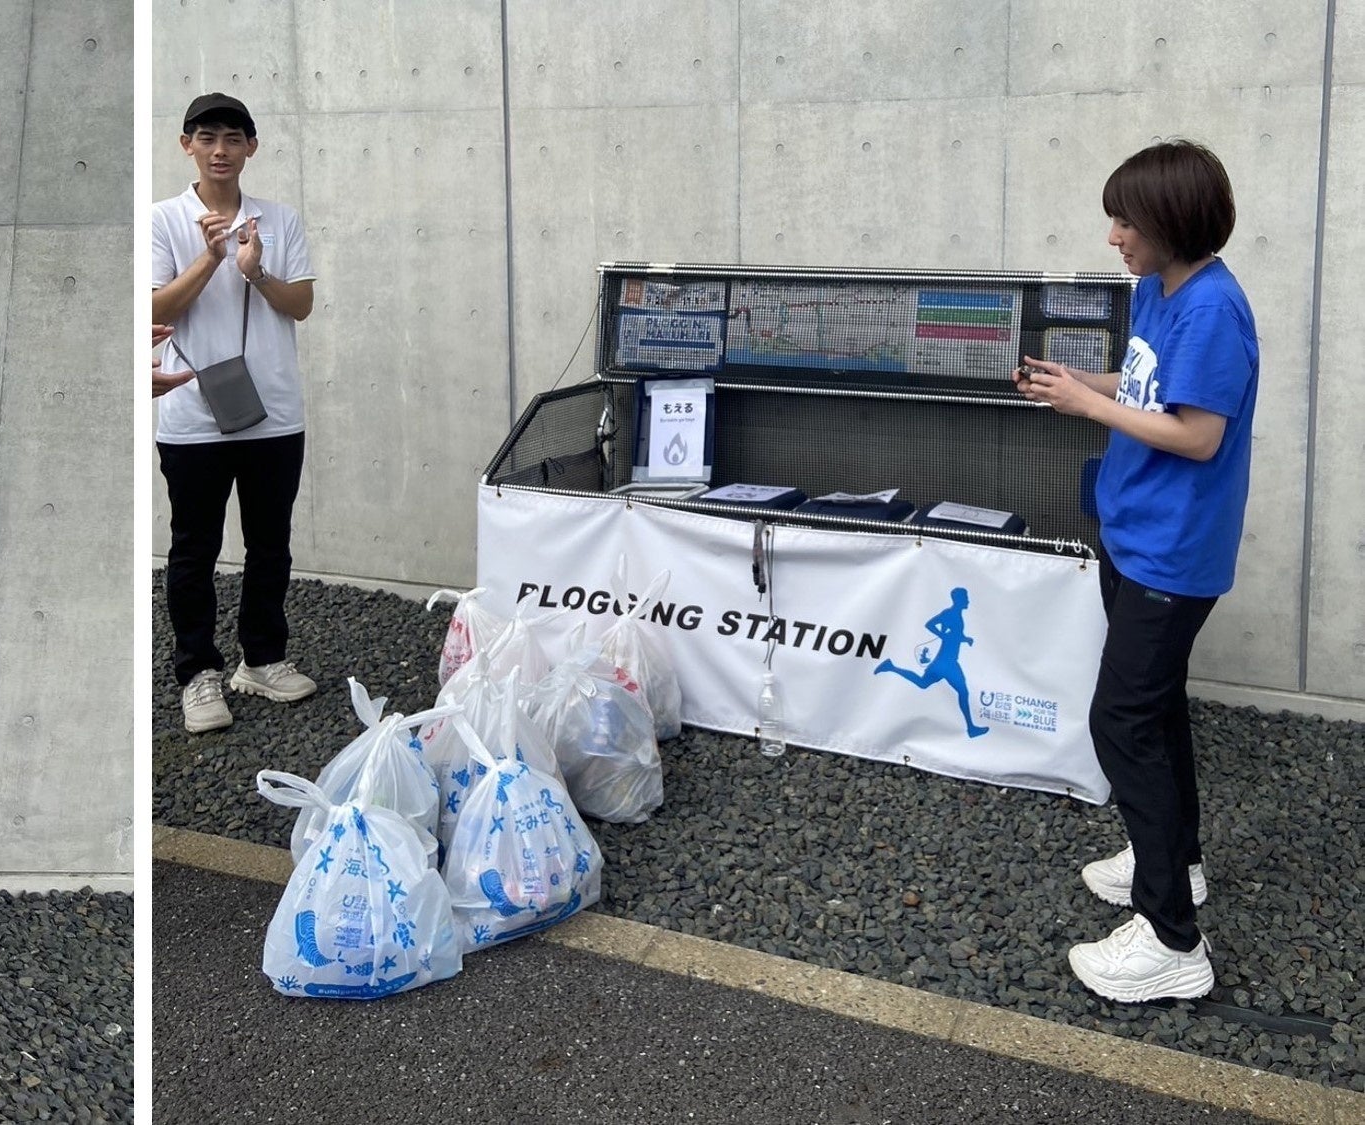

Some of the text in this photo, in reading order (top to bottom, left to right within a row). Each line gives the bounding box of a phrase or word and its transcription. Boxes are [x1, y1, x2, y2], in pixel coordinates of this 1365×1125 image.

[663, 403, 693, 414] もえる
[716, 610, 887, 660] STATION
[995, 692, 1012, 701] 日本
[1014, 695, 1058, 710] CHANGE
[1033, 714, 1057, 727] BLUE
